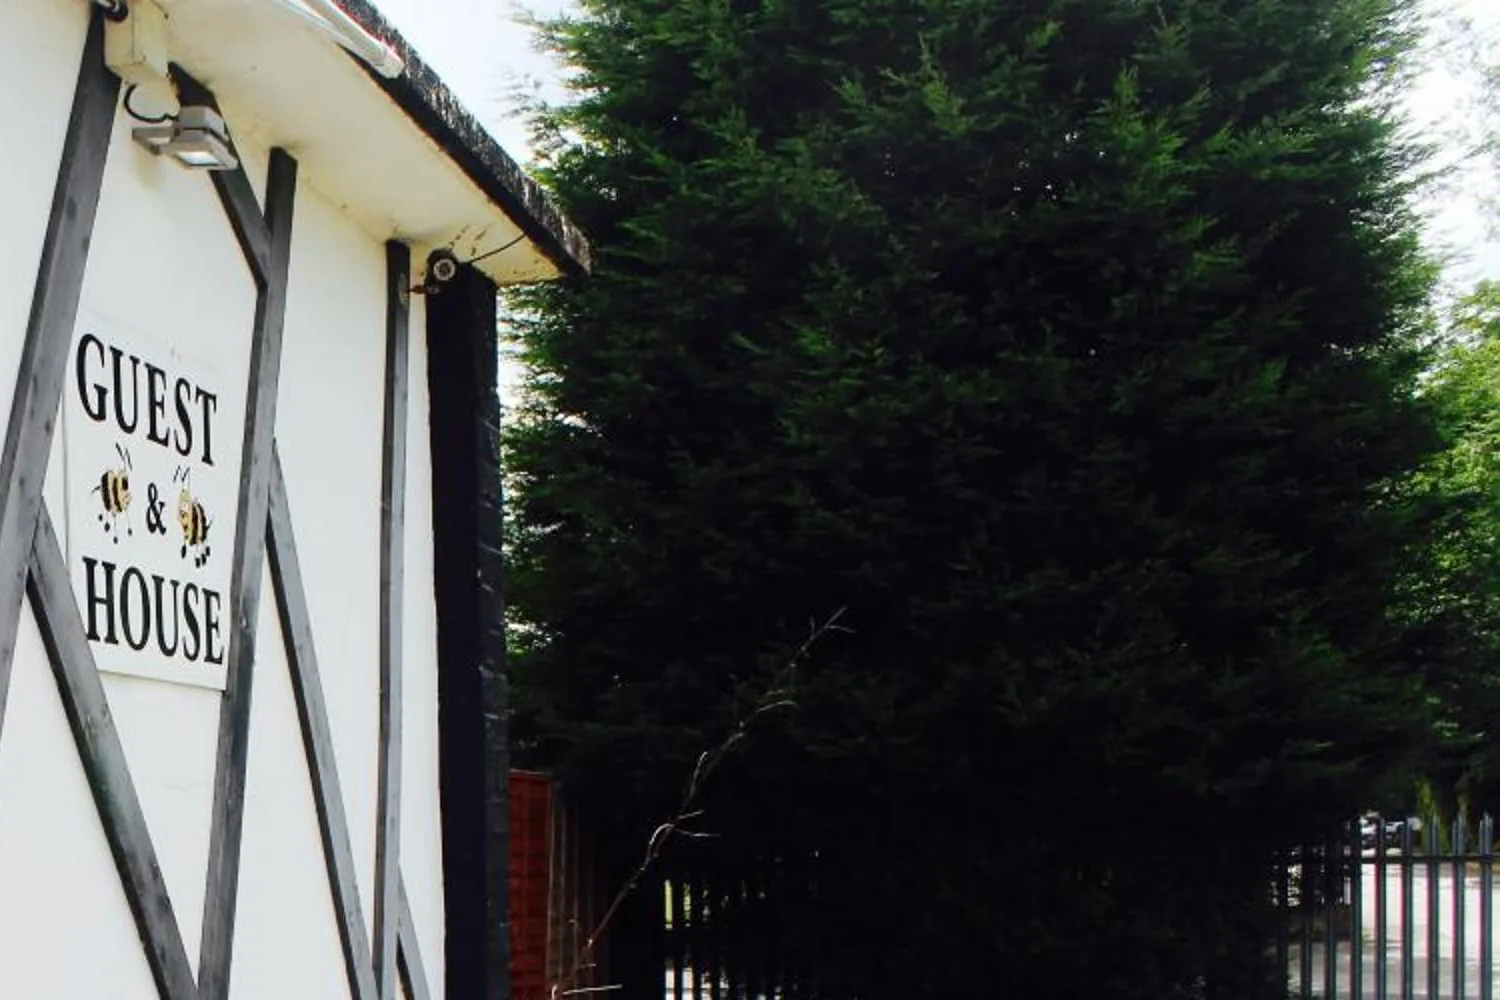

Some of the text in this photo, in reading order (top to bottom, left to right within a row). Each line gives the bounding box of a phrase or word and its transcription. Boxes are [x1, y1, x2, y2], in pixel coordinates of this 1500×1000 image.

[76, 333, 217, 466] GUEST
[146, 482, 167, 536] &
[82, 556, 224, 666] HOUSE
